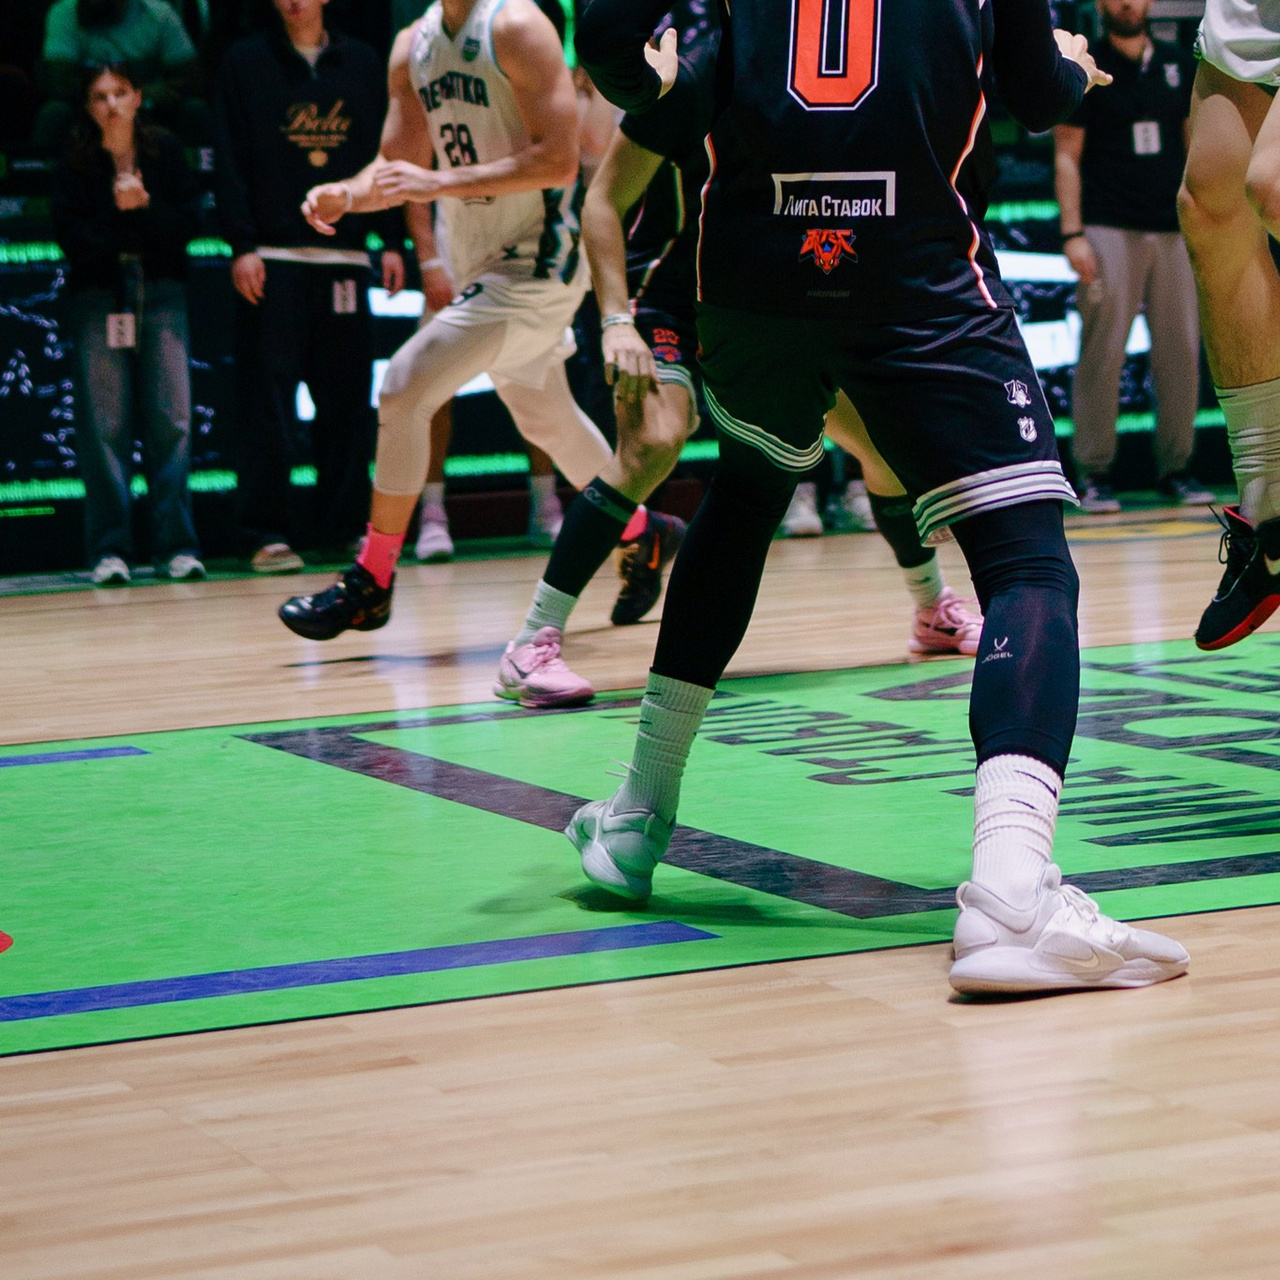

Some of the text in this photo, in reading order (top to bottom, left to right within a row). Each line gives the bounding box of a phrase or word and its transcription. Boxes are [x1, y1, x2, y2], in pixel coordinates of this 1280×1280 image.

[440, 123, 479, 167] 28
[784, 195, 882, 217] ЛИГА СТАВОК
